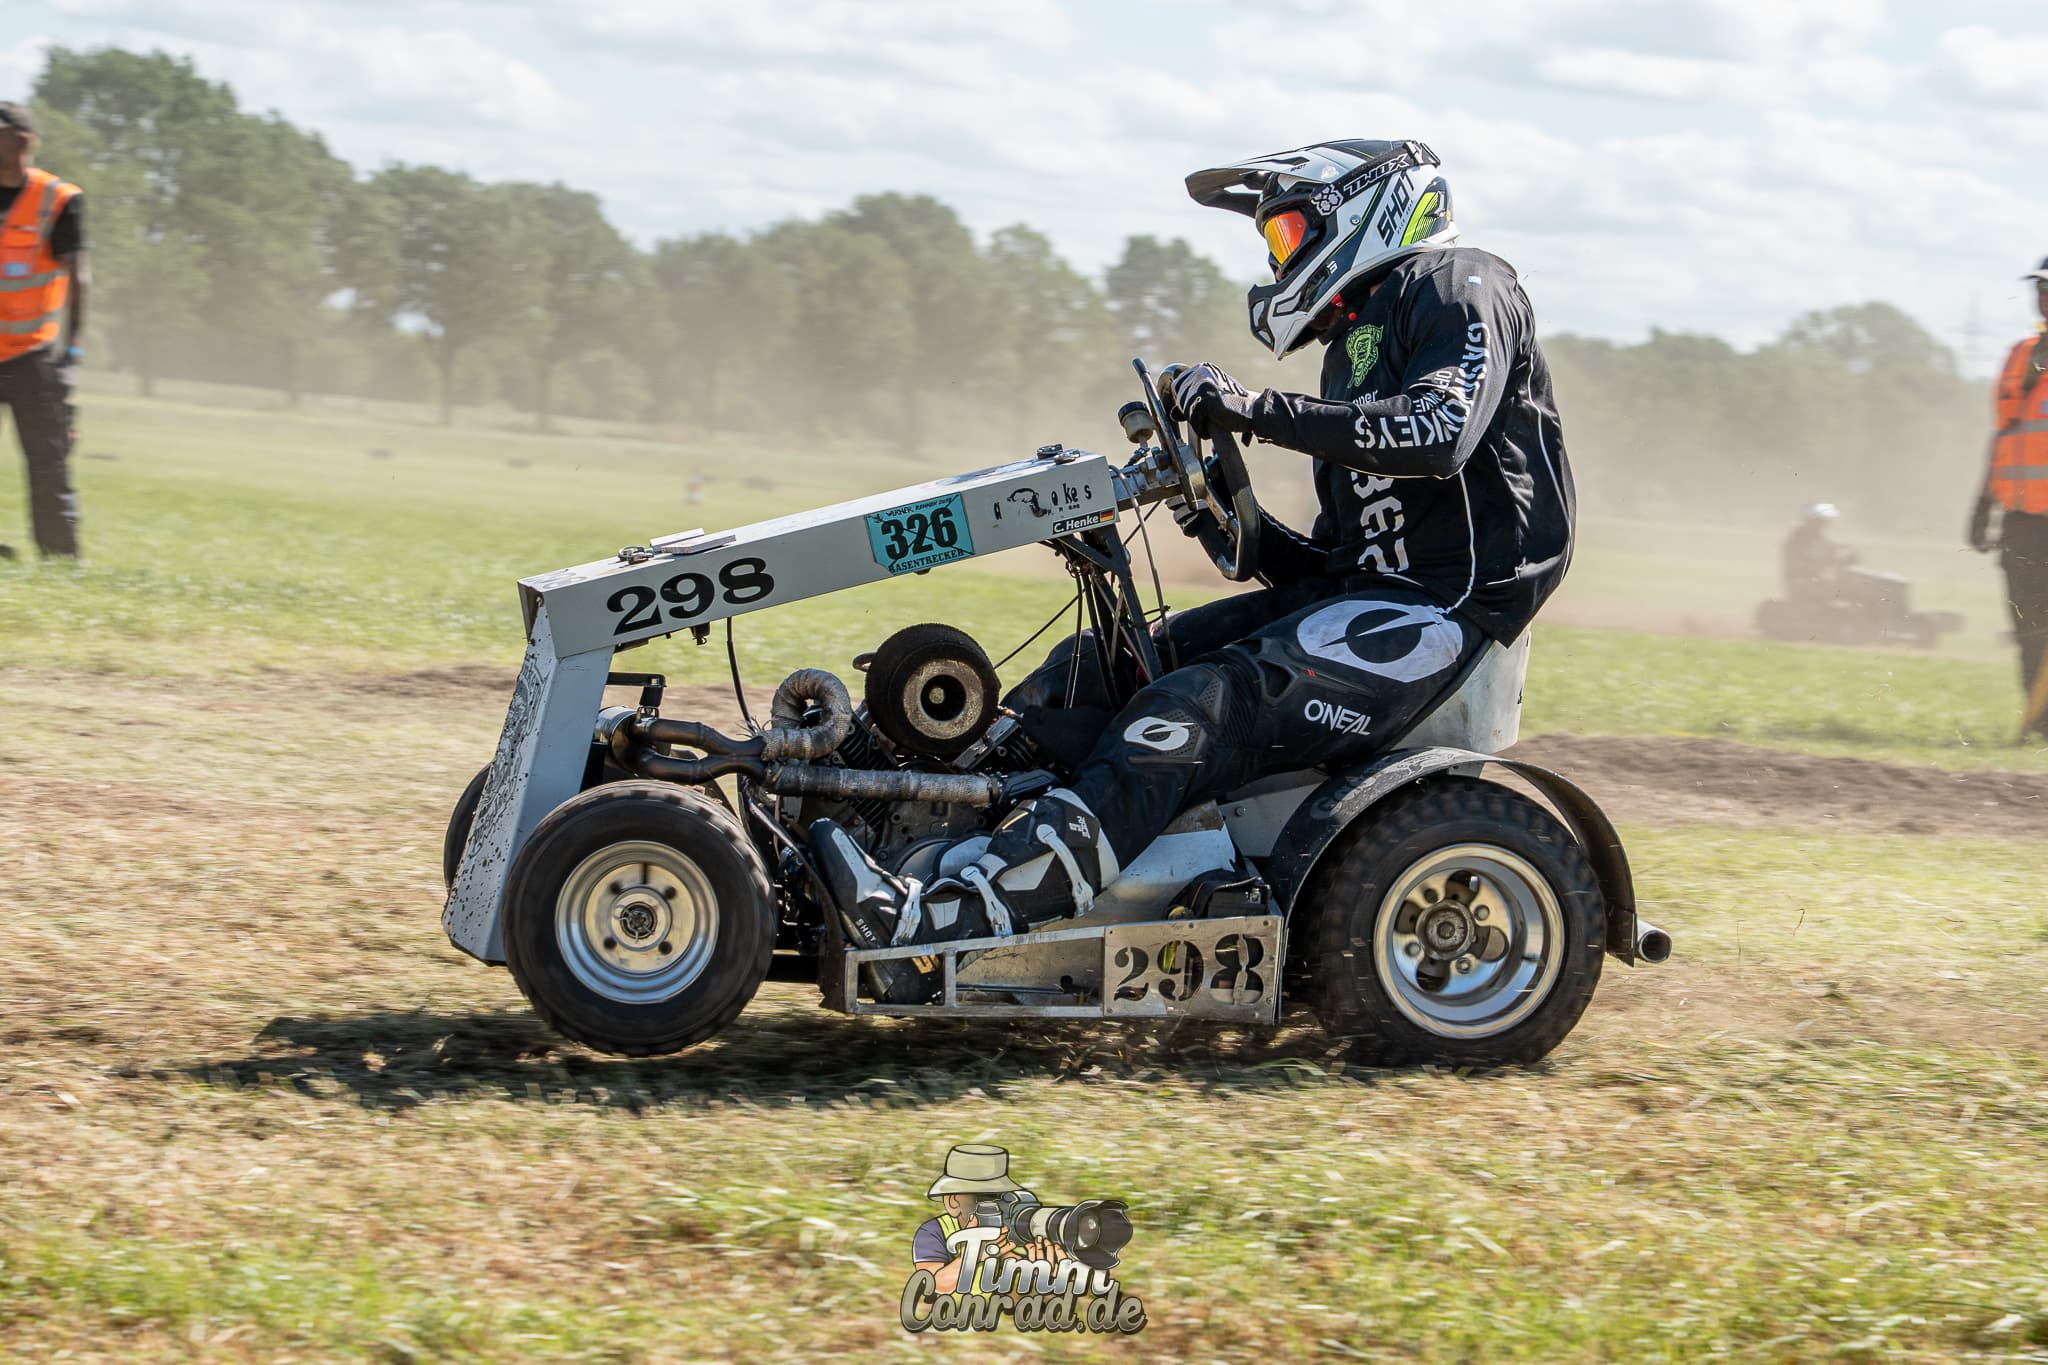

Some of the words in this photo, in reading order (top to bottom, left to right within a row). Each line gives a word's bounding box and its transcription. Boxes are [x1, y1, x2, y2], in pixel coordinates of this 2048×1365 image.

[1377, 168, 1415, 249] SHOT
[880, 507, 958, 561] 326
[1054, 524, 1065, 533] C.
[1066, 514, 1099, 530] Henke
[888, 549, 966, 574] RASENTRECKER
[606, 557, 775, 636] 298
[1304, 700, 1373, 735] O'NEAL
[1114, 934, 1264, 1005] 298
